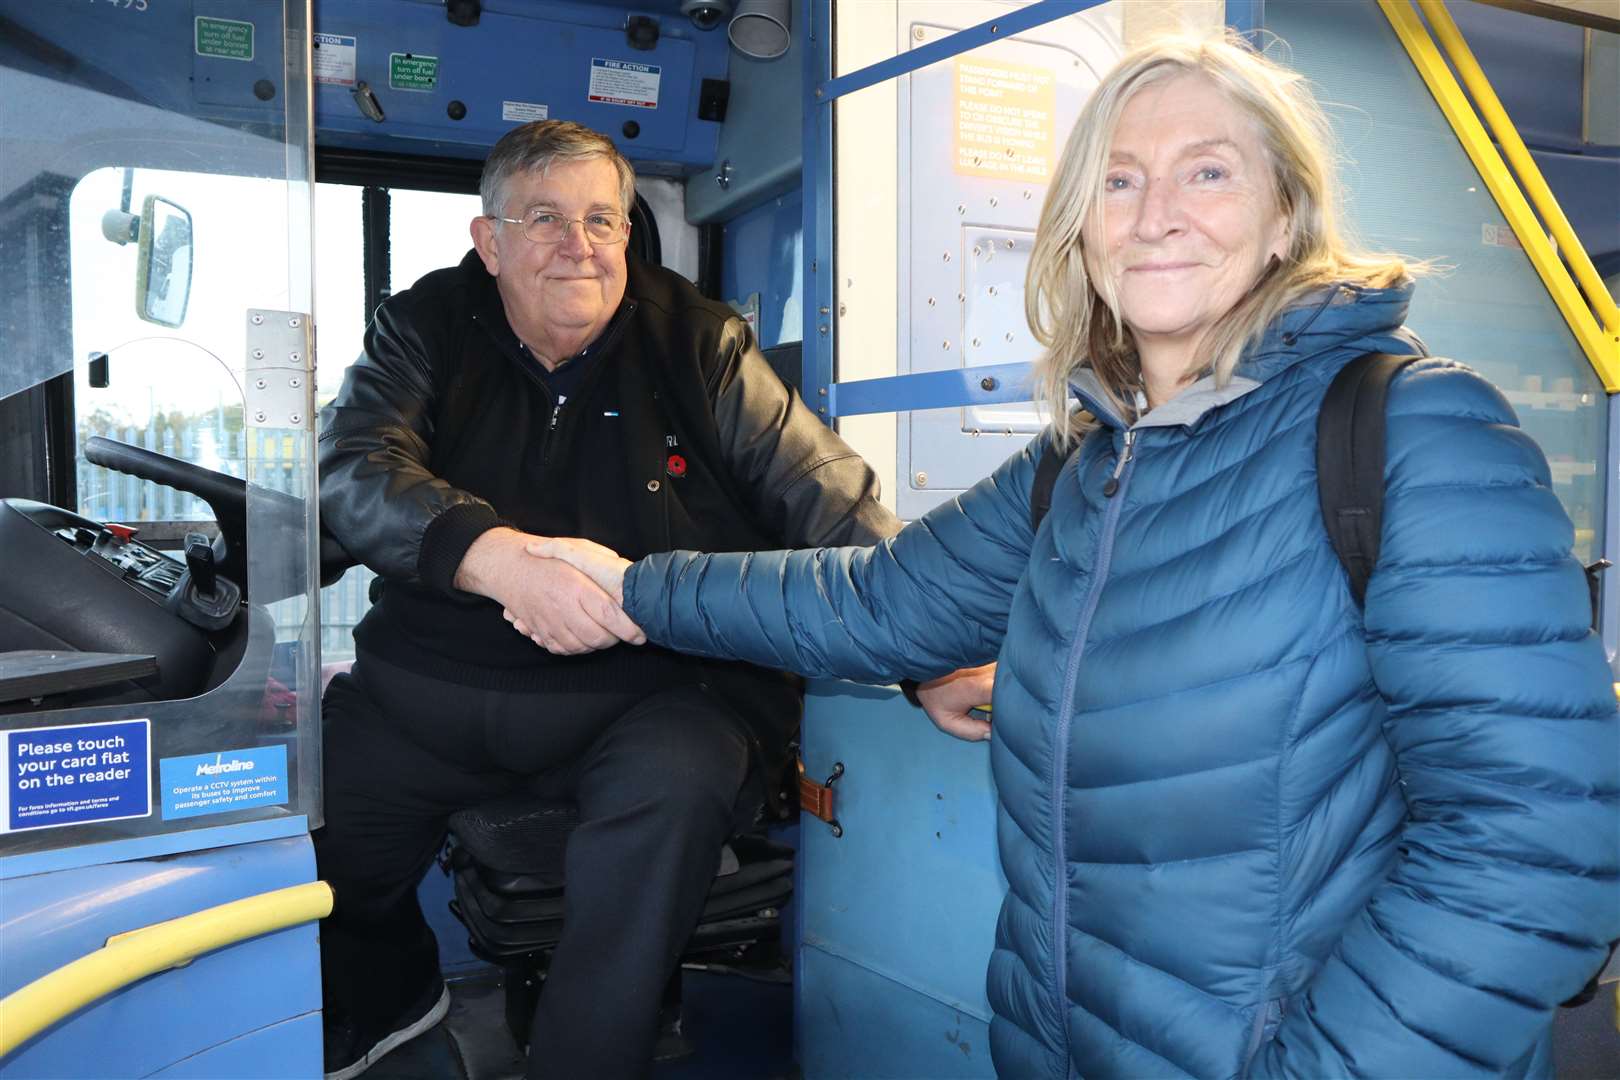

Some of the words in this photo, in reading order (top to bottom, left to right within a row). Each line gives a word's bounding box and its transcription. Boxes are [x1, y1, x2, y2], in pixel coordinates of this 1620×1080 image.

[313, 35, 342, 45] CTION
[402, 59, 436, 68] emergency
[605, 61, 621, 69] FIRE
[622, 64, 649, 72] ACTION
[397, 65, 411, 73] turn
[422, 68, 434, 76] fuel
[415, 74, 437, 82] bonnt
[18, 742, 72, 757] Please
[77, 735, 125, 751] touch
[18, 759, 57, 776] your
[61, 753, 97, 769] card
[101, 751, 130, 765] flat
[196, 755, 255, 776] Metroline
[18, 778, 40, 790] on
[46, 773, 74, 787] the
[79, 768, 131, 783] reader
[173, 784, 203, 795] Operate
[210, 780, 229, 790] CCTV
[230, 779, 254, 789] system
[254, 775, 277, 784] within
[202, 790, 221, 799] buses
[232, 785, 260, 795] improve
[44, 801, 79, 810] information
[175, 798, 210, 810] passenger
[212, 794, 233, 805] safety
[234, 793, 249, 801] and
[249, 789, 277, 799] comfort
[18, 809, 49, 817] conditions
